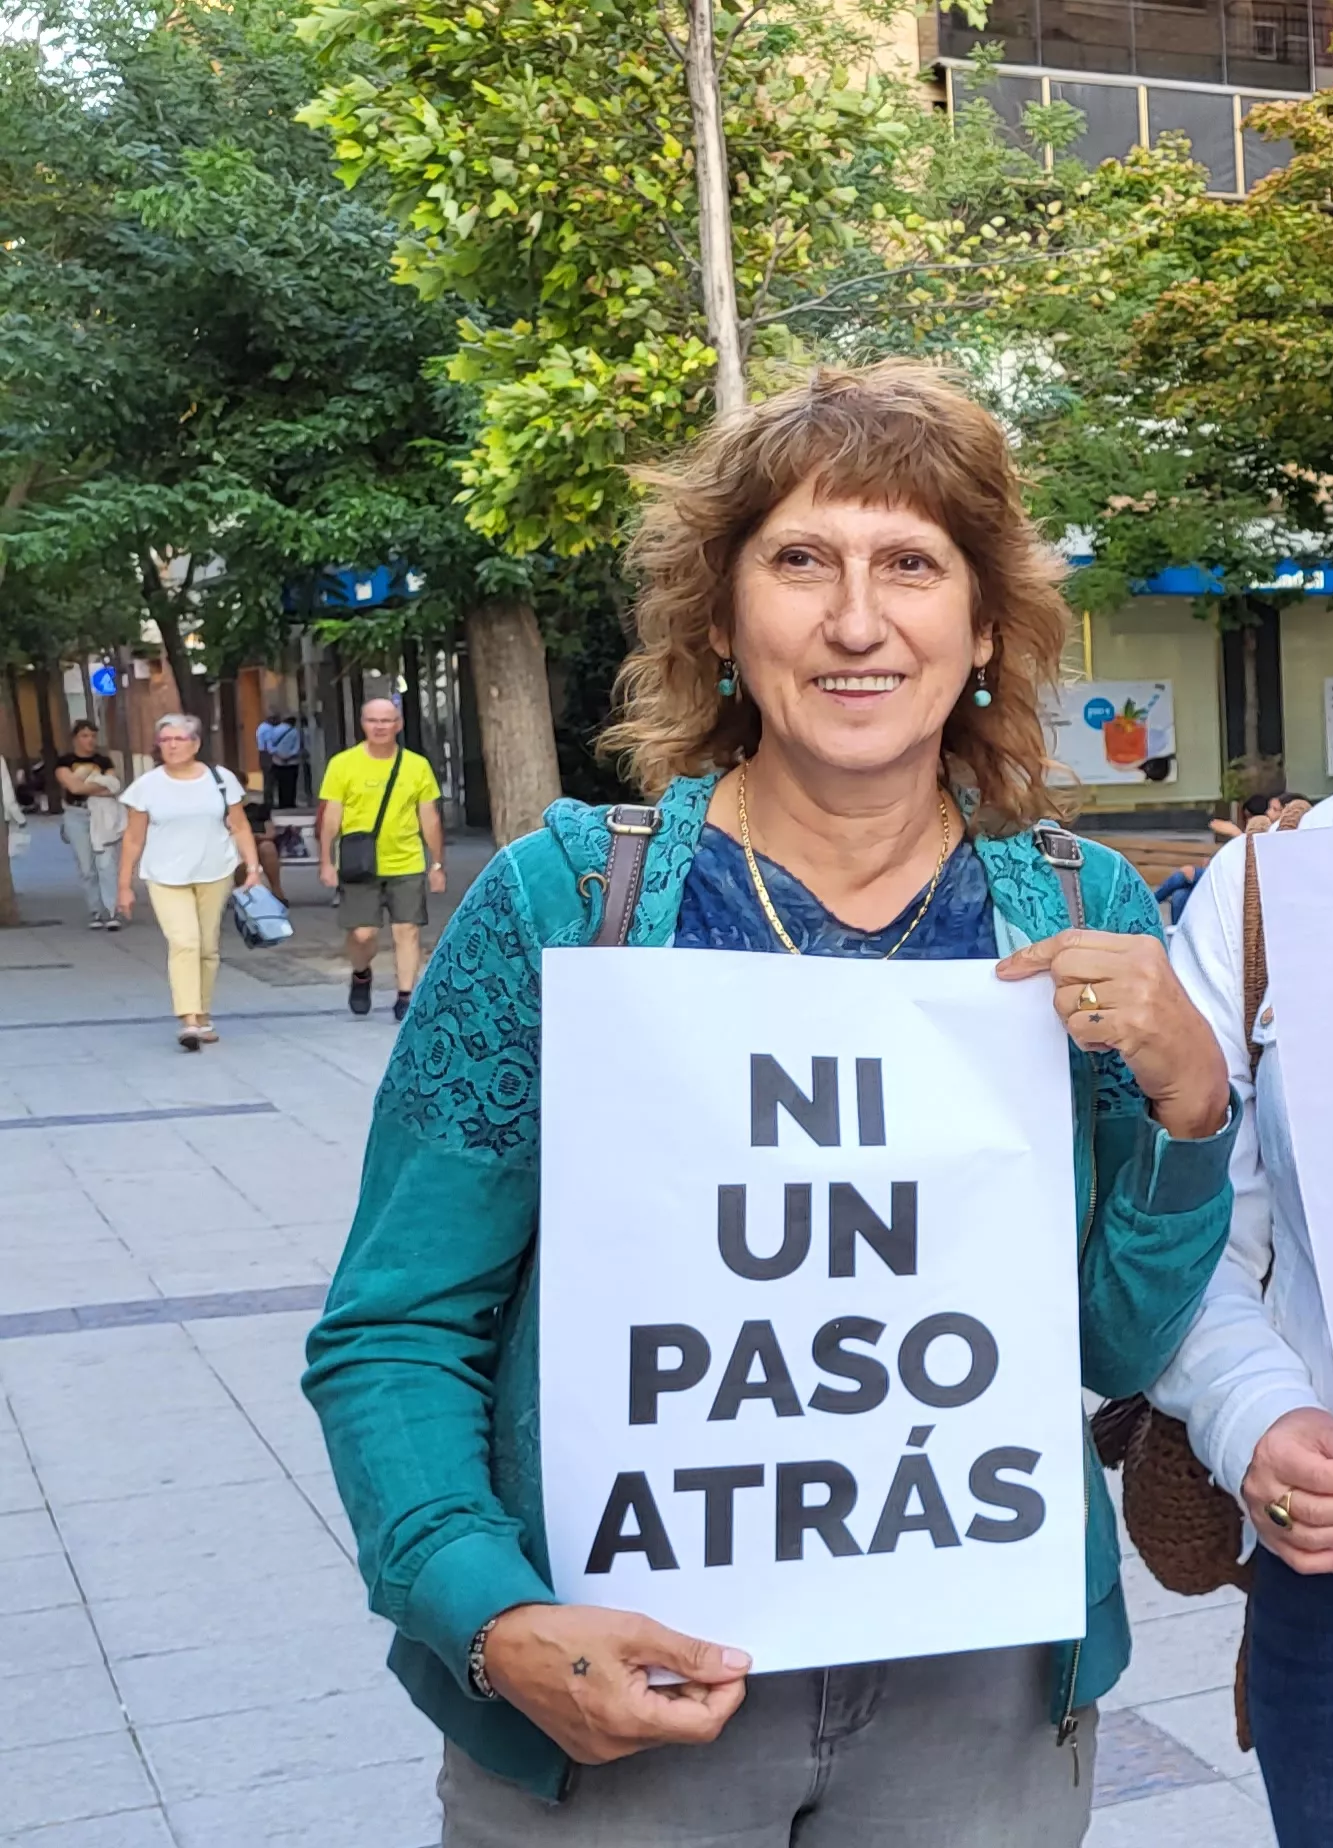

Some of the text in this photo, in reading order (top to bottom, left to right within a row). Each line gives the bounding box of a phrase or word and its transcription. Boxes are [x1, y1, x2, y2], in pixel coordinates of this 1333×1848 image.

[750, 1054, 886, 1147] NI
[716, 1181, 918, 1281] UN
[628, 1312, 999, 1425] PASO
[584, 1425, 1046, 1575] ATRÁS
